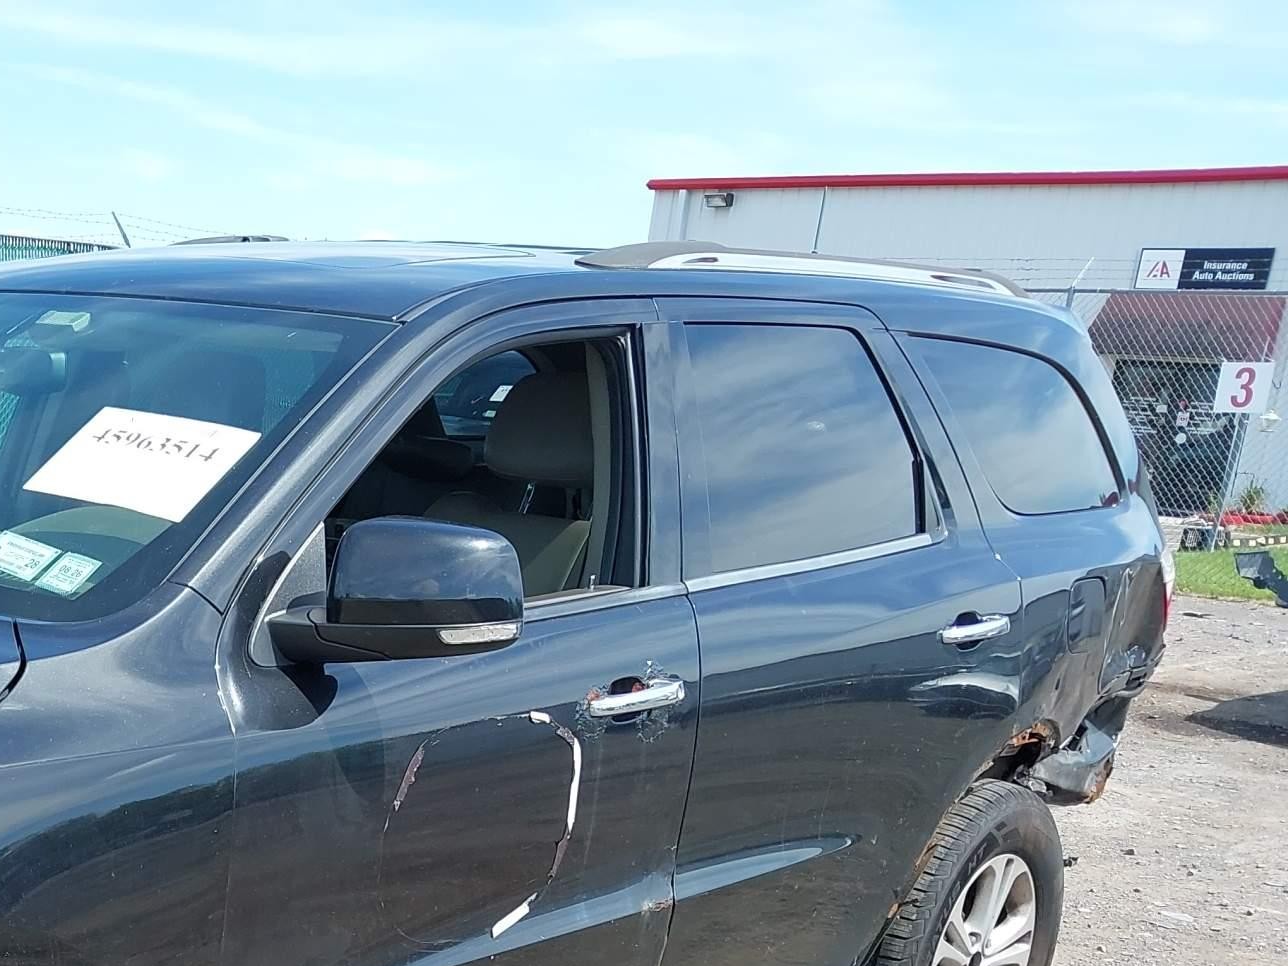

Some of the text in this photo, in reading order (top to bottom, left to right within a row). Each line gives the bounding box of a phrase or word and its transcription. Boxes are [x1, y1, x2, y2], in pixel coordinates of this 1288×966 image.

[1192, 271, 1254, 280] Auto Auctions
[1203, 261, 1248, 271] Insurance
[1230, 367, 1256, 408] 3
[92, 428, 220, 462] 45963514
